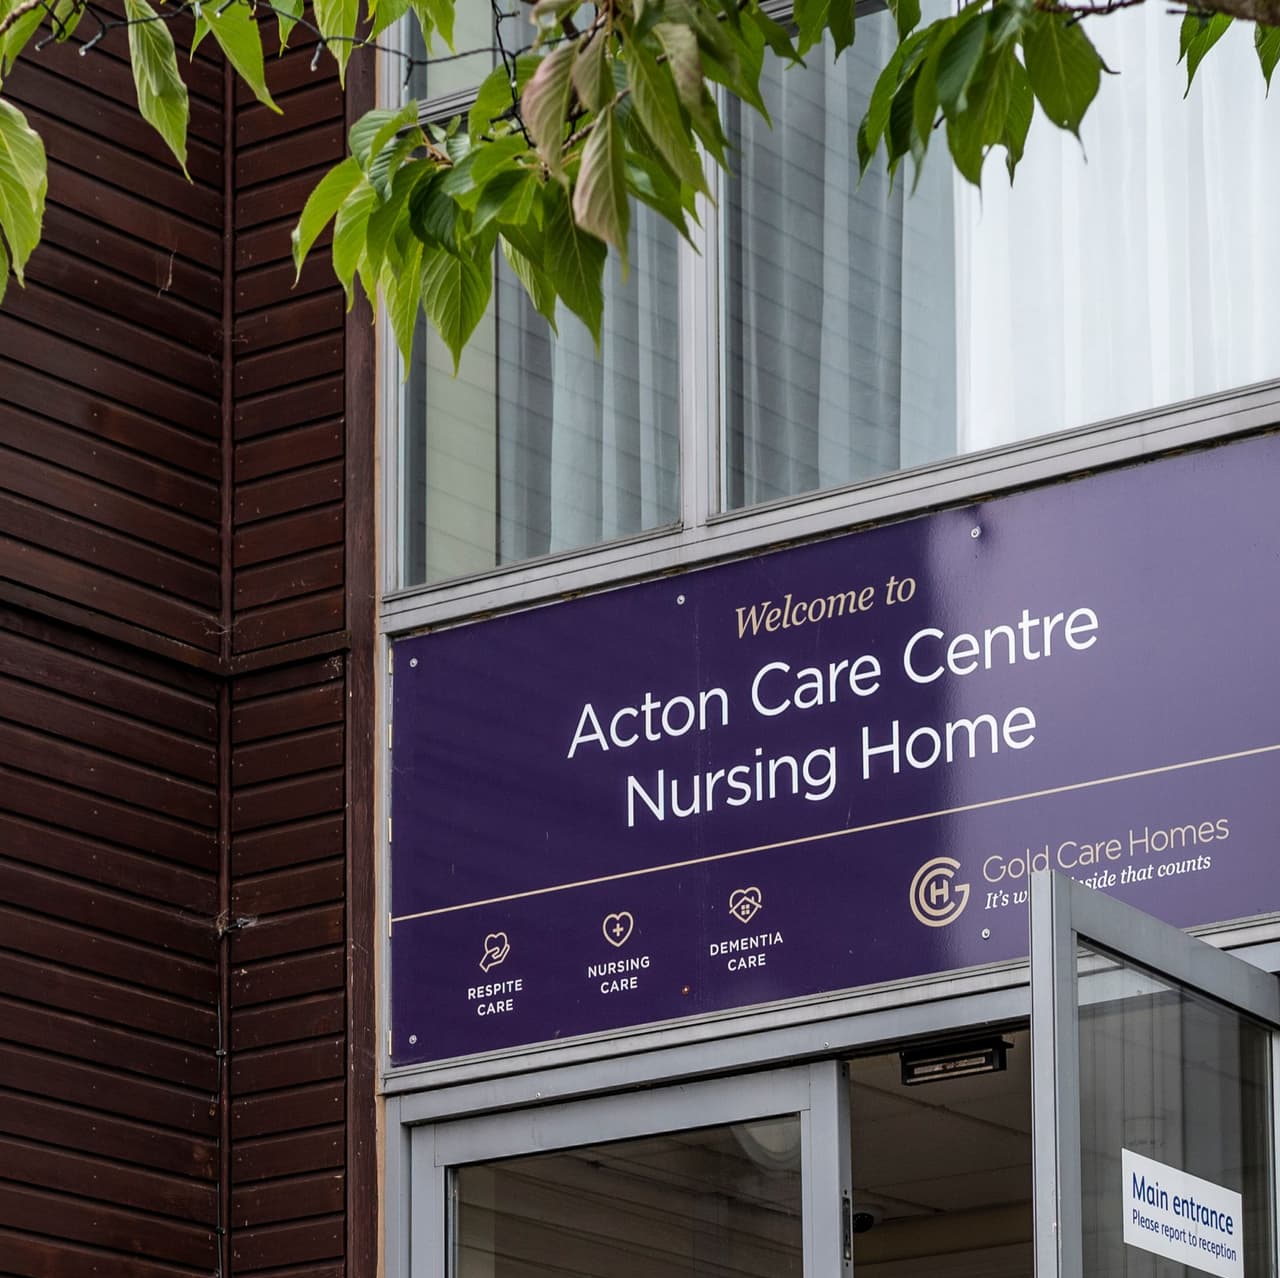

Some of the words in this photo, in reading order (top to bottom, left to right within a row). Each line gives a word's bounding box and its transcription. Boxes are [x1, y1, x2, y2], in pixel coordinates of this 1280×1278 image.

[735, 582, 874, 639] Welcome
[885, 577, 916, 604] to
[567, 687, 729, 758] Acton
[751, 655, 881, 716] Care
[904, 606, 1099, 683] Centre
[627, 746, 837, 827] Nursing
[862, 706, 1036, 779] Home
[983, 845, 1050, 883] Gold
[1057, 838, 1122, 869] Care
[1129, 818, 1229, 856] Homes
[1071, 871, 1116, 890] side
[1120, 866, 1154, 884] that
[1157, 854, 1211, 878] counts
[709, 931, 784, 957] DEMENTIA
[587, 956, 651, 979] NURSING
[727, 954, 767, 972] CARE
[467, 978, 523, 1001] RESPITE
[600, 976, 639, 994] CARE
[477, 999, 514, 1017] CARE
[1133, 1171, 1169, 1211] Main
[1173, 1195, 1233, 1236] entrance
[1132, 1208, 1160, 1233] Please
[1161, 1223, 1187, 1243] report
[1188, 1230, 1197, 1247] to
[1199, 1237, 1237, 1262] reception
